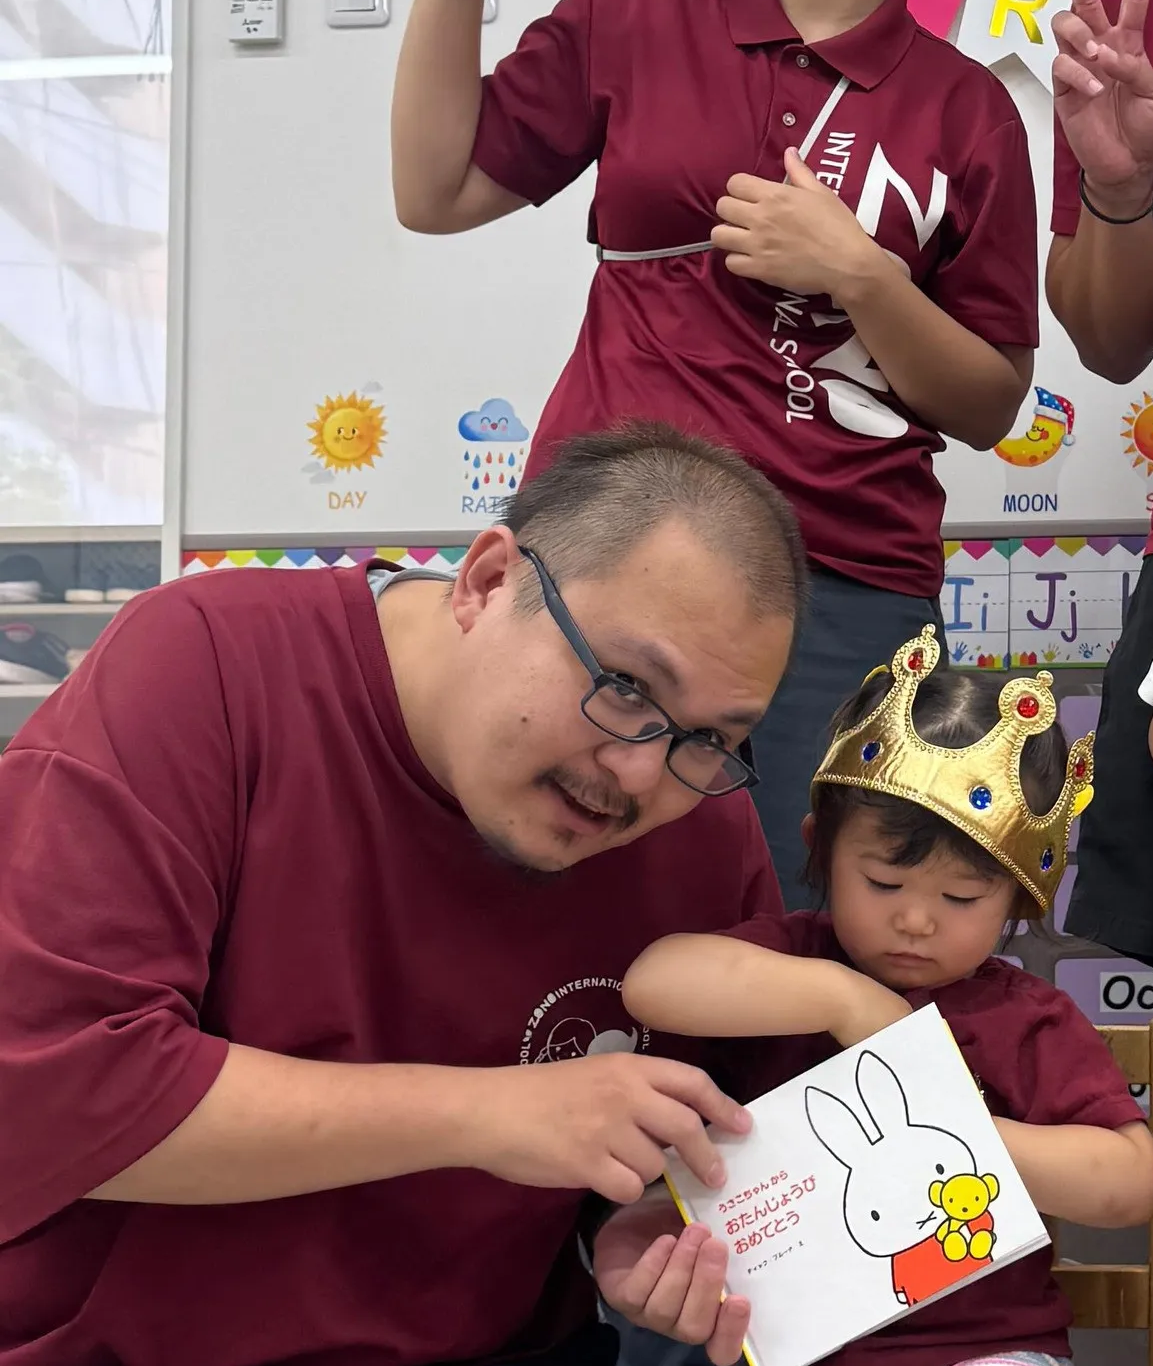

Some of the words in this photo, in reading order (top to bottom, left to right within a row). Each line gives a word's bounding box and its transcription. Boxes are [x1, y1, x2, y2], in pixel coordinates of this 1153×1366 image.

[328, 491, 368, 510] DAY
[1003, 493, 1058, 513] MOON
[725, 1175, 816, 1235] おたんじょうび
